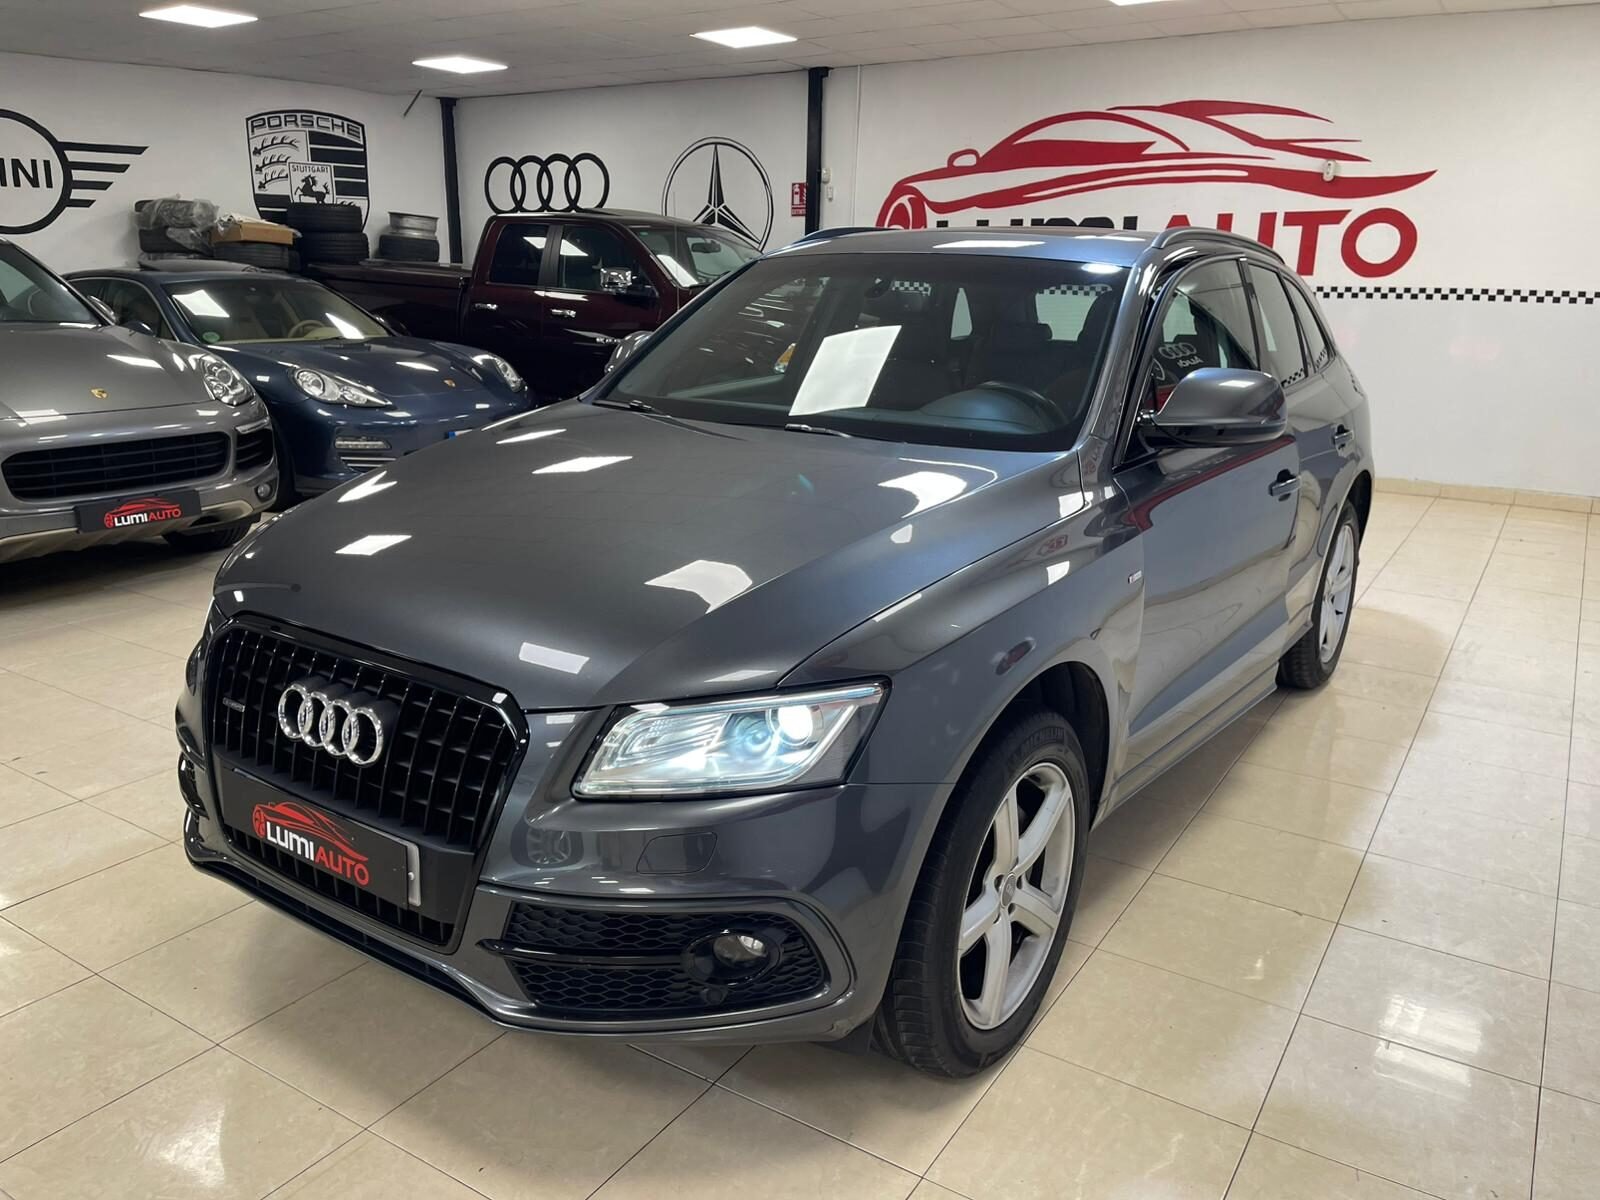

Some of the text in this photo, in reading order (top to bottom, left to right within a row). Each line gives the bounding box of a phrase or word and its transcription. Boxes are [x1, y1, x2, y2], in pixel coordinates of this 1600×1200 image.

[250, 114, 362, 142] PORSCHE
[0, 157, 54, 189] INI
[291, 164, 329, 174] STUTTGART
